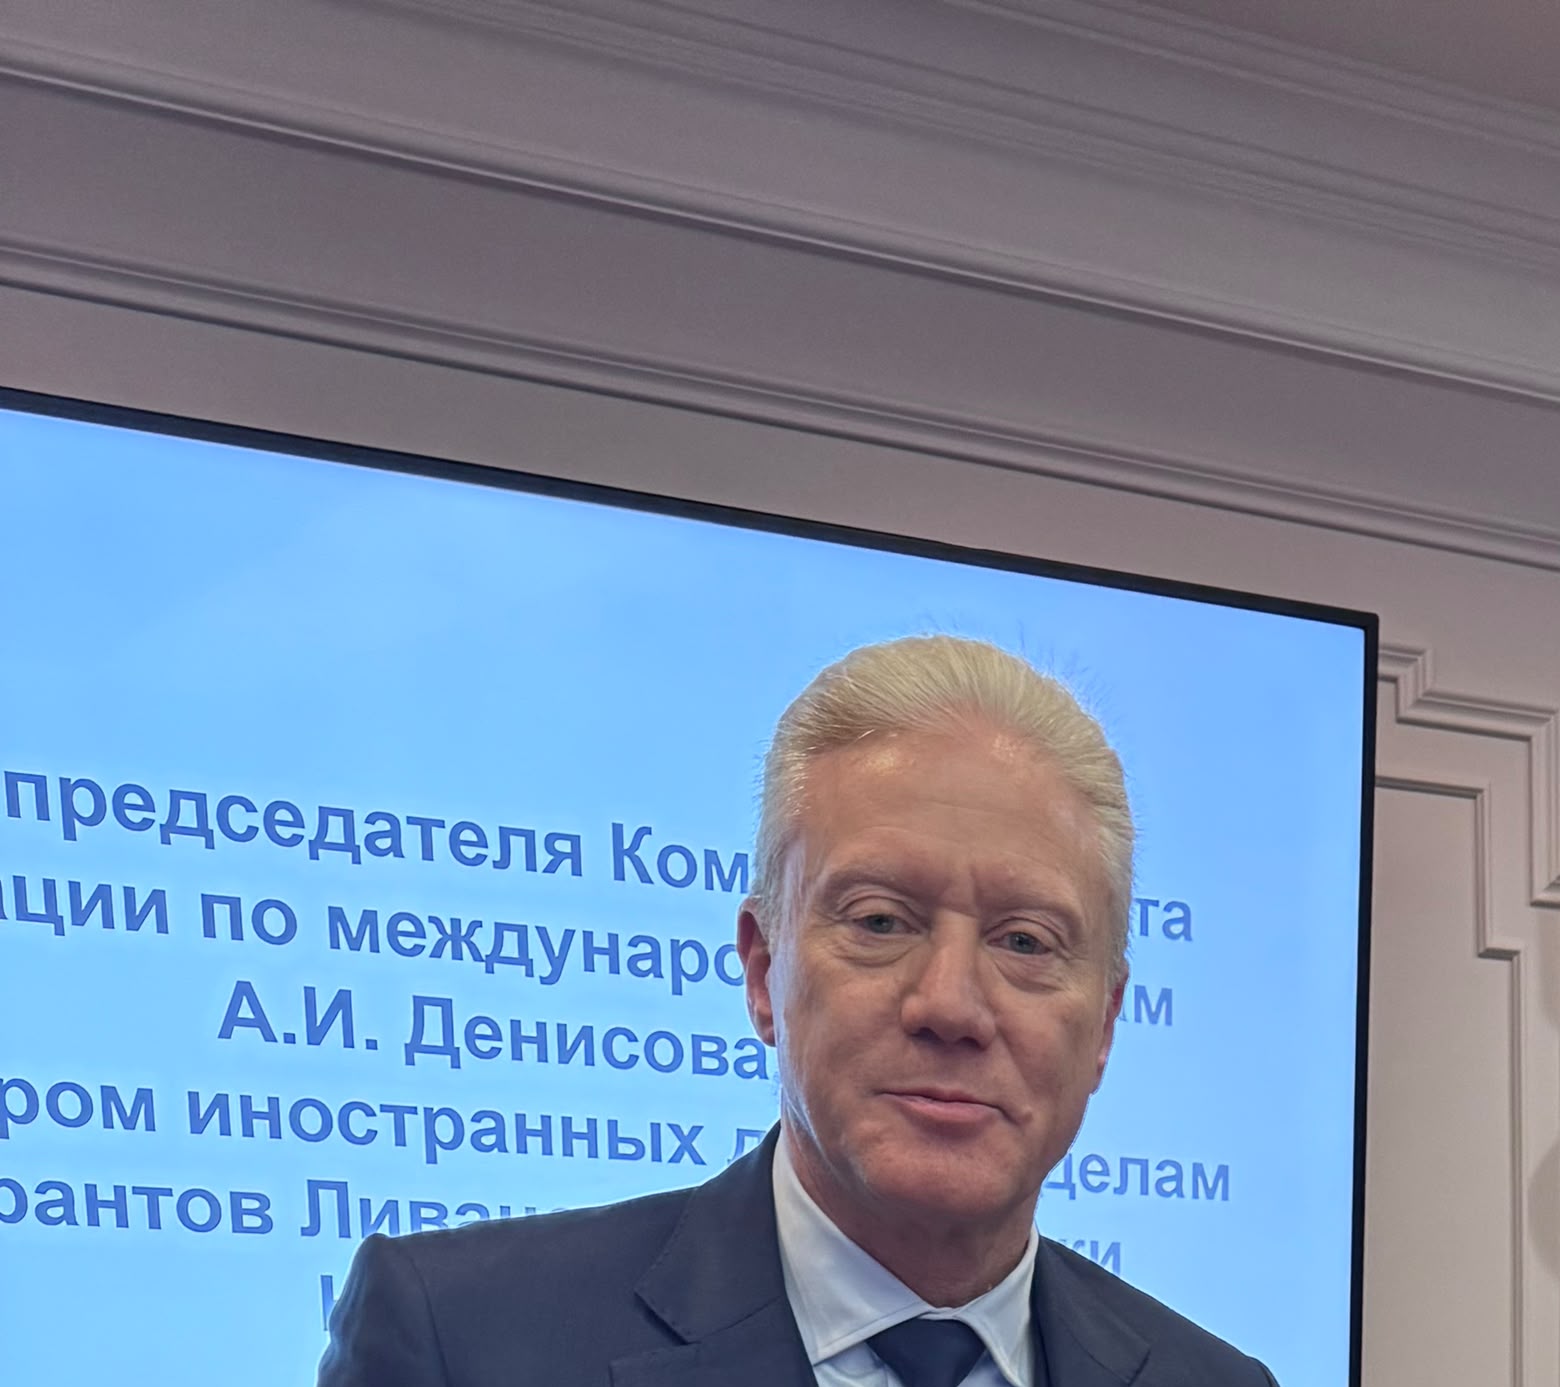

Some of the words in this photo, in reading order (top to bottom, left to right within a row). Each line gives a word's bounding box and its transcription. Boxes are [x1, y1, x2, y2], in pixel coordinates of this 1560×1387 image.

[4, 771, 583, 878] председателя
[612, 823, 749, 894] Ком
[0, 875, 169, 937] ции
[201, 894, 298, 946] по
[328, 906, 745, 996] междунаро
[218, 981, 379, 1051] А.И.
[405, 995, 769, 1080] Денисова
[0, 1078, 157, 1140] ром
[188, 1091, 707, 1166] иностранных
